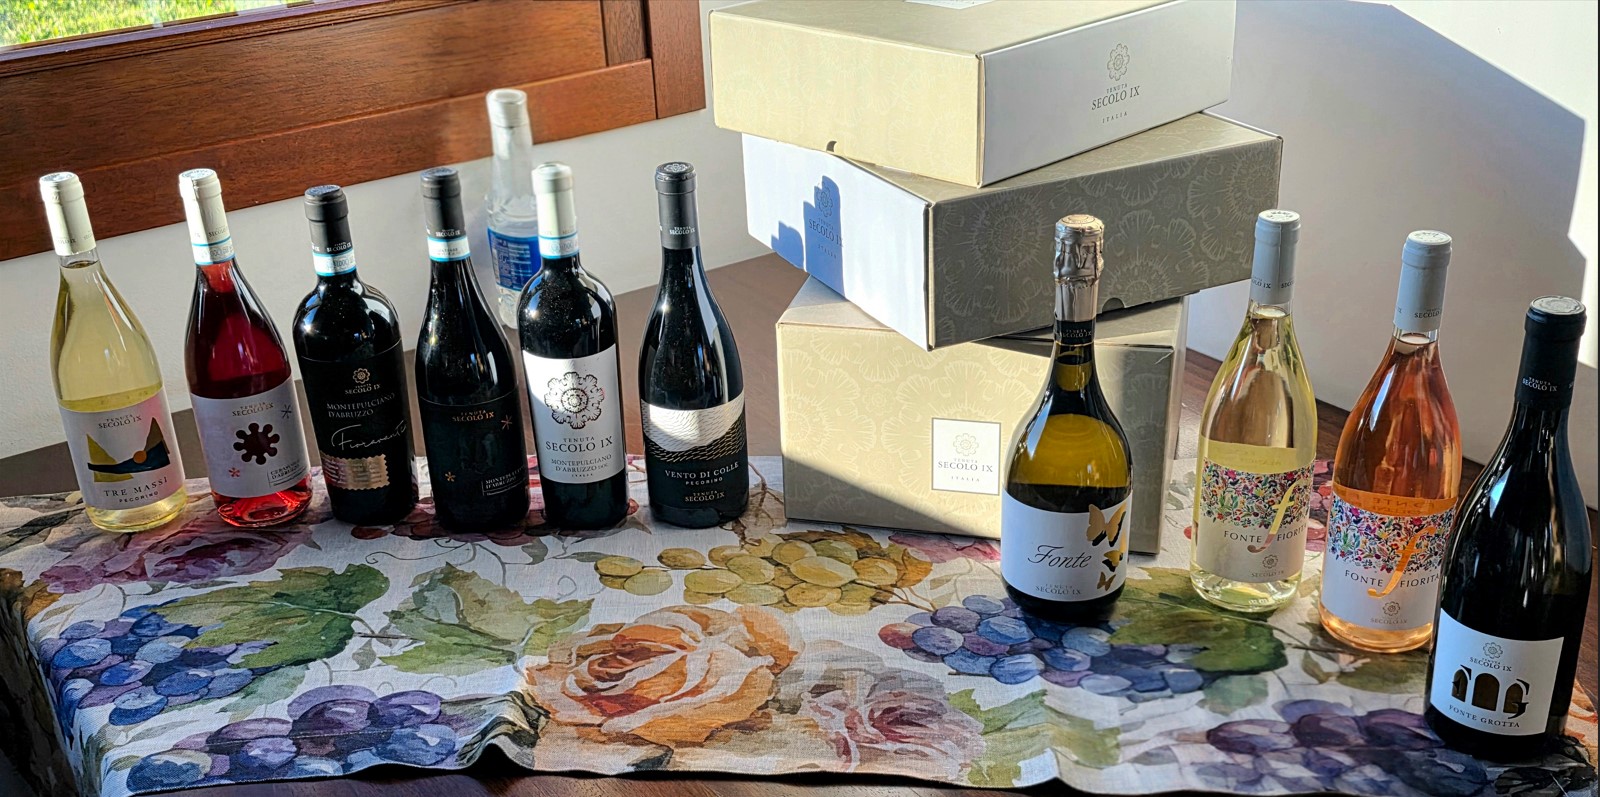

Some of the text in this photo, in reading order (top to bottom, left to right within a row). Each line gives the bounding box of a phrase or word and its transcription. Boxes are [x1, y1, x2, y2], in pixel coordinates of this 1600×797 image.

[1106, 83, 1128, 94] TENUTA
[1091, 85, 1140, 111] SECOLO IX
[1102, 111, 1128, 124] ITALIA
[808, 218, 835, 242] SECOLO
[344, 386, 372, 395] SECOLO
[1522, 378, 1548, 391] SECOLO
[326, 392, 396, 410] MONTEPULCIANO
[232, 402, 274, 417] SECOLO IX
[328, 408, 374, 418] D'ABRUZZO
[452, 411, 495, 422] SECOLO IX
[98, 420, 131, 429] SECOLO
[545, 436, 614, 453] SECOLO IX
[551, 454, 612, 467] MONTEPULCIANO
[938, 461, 993, 472] SECOLO IX
[556, 465, 597, 473] D'ABRUZZO
[664, 462, 740, 479] VENTO DI COLLE
[103, 476, 168, 498] TRE MASSI
[686, 477, 723, 486] PECORINO
[119, 491, 160, 503] PECORINO
[685, 494, 715, 502] SECOLO
[1224, 530, 1262, 543] FONTE
[1027, 544, 1092, 568] Fonte
[1344, 570, 1440, 588] FONTE FIORITA
[1035, 586, 1069, 595] SECOLO
[1470, 656, 1501, 670] SECOLO
[1448, 704, 1520, 728] FONTE GROTTA
